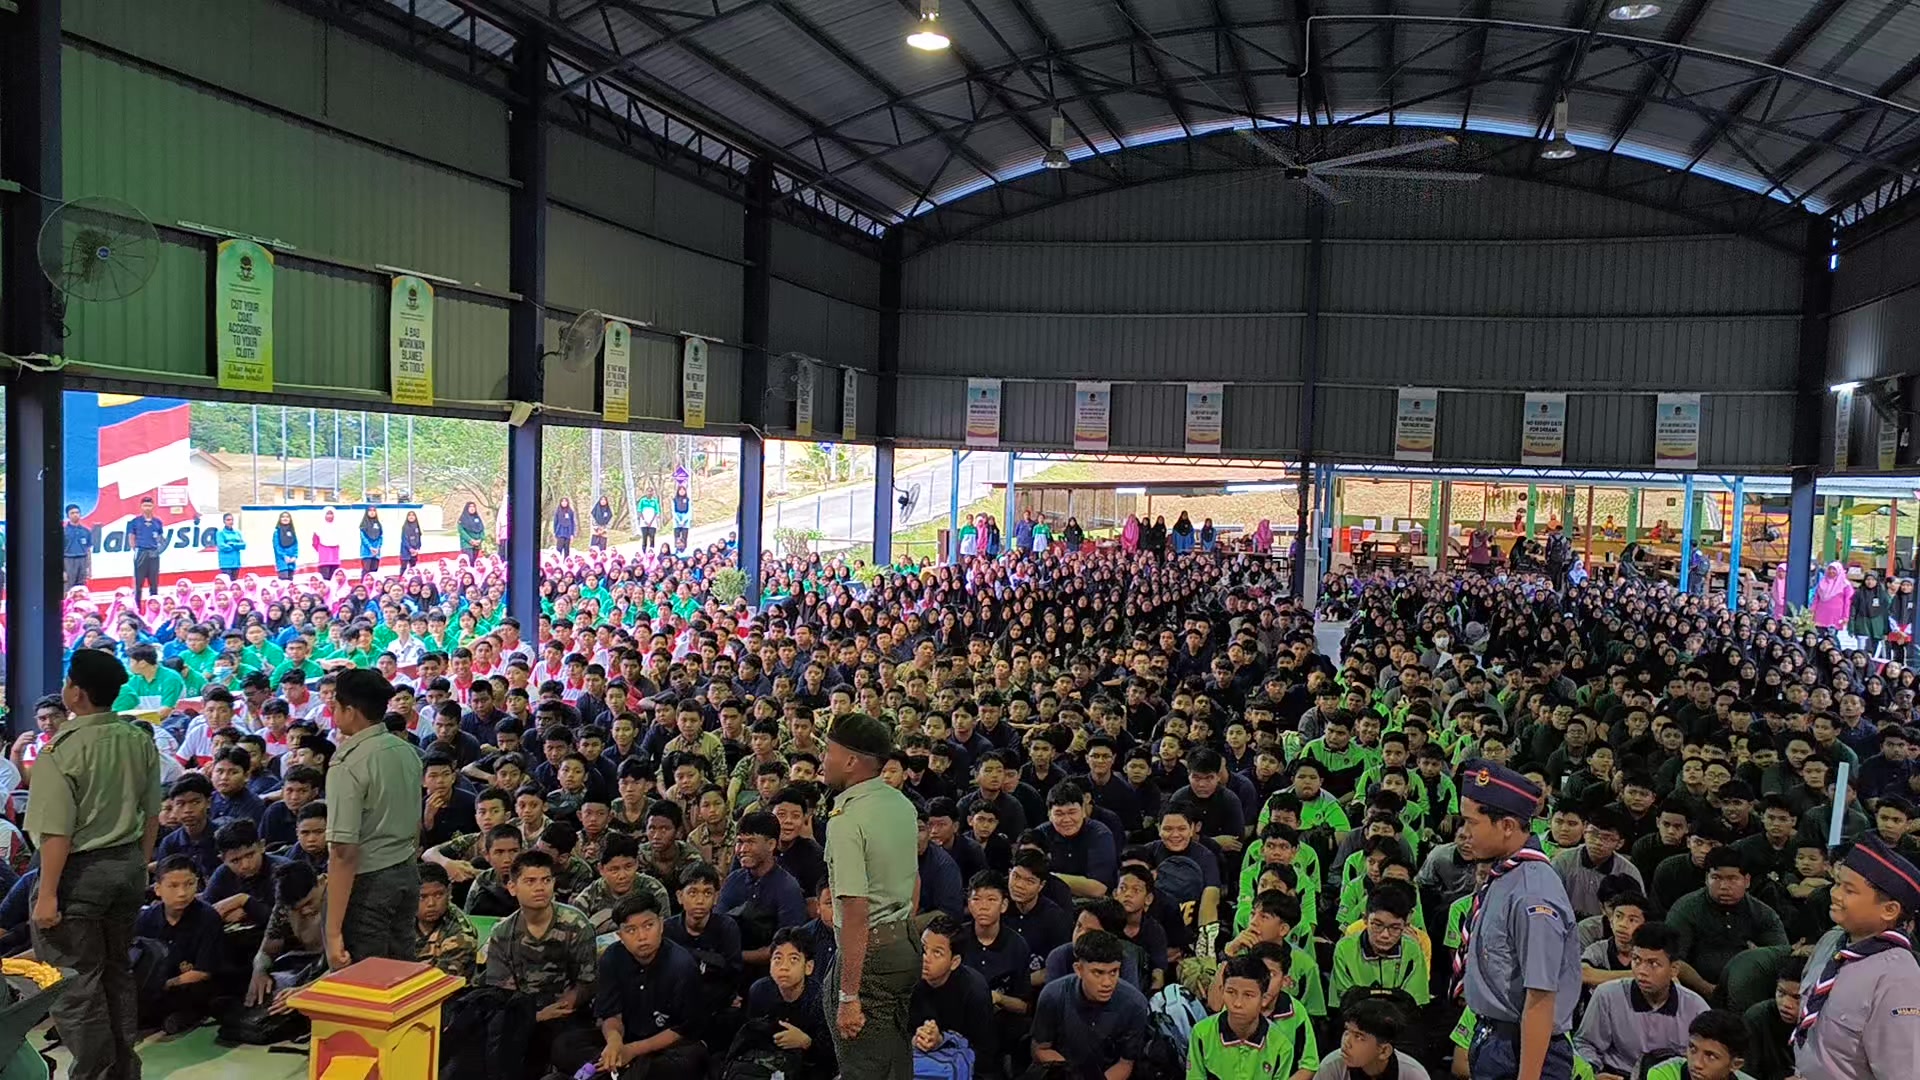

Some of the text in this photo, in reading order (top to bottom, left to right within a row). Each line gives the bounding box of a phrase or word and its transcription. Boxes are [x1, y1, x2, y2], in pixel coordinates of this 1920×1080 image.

[231, 299, 259, 312] CUT YOUR
[237, 312, 253, 323] COAT
[228, 322, 262, 336] ACCORDING
[232, 334, 257, 347] TO YOUR
[399, 337, 425, 350] WORKMAN
[236, 347, 255, 359] CLOTH
[401, 349, 423, 362] BLAMES
[400, 361, 425, 374] HIS TOOLS
